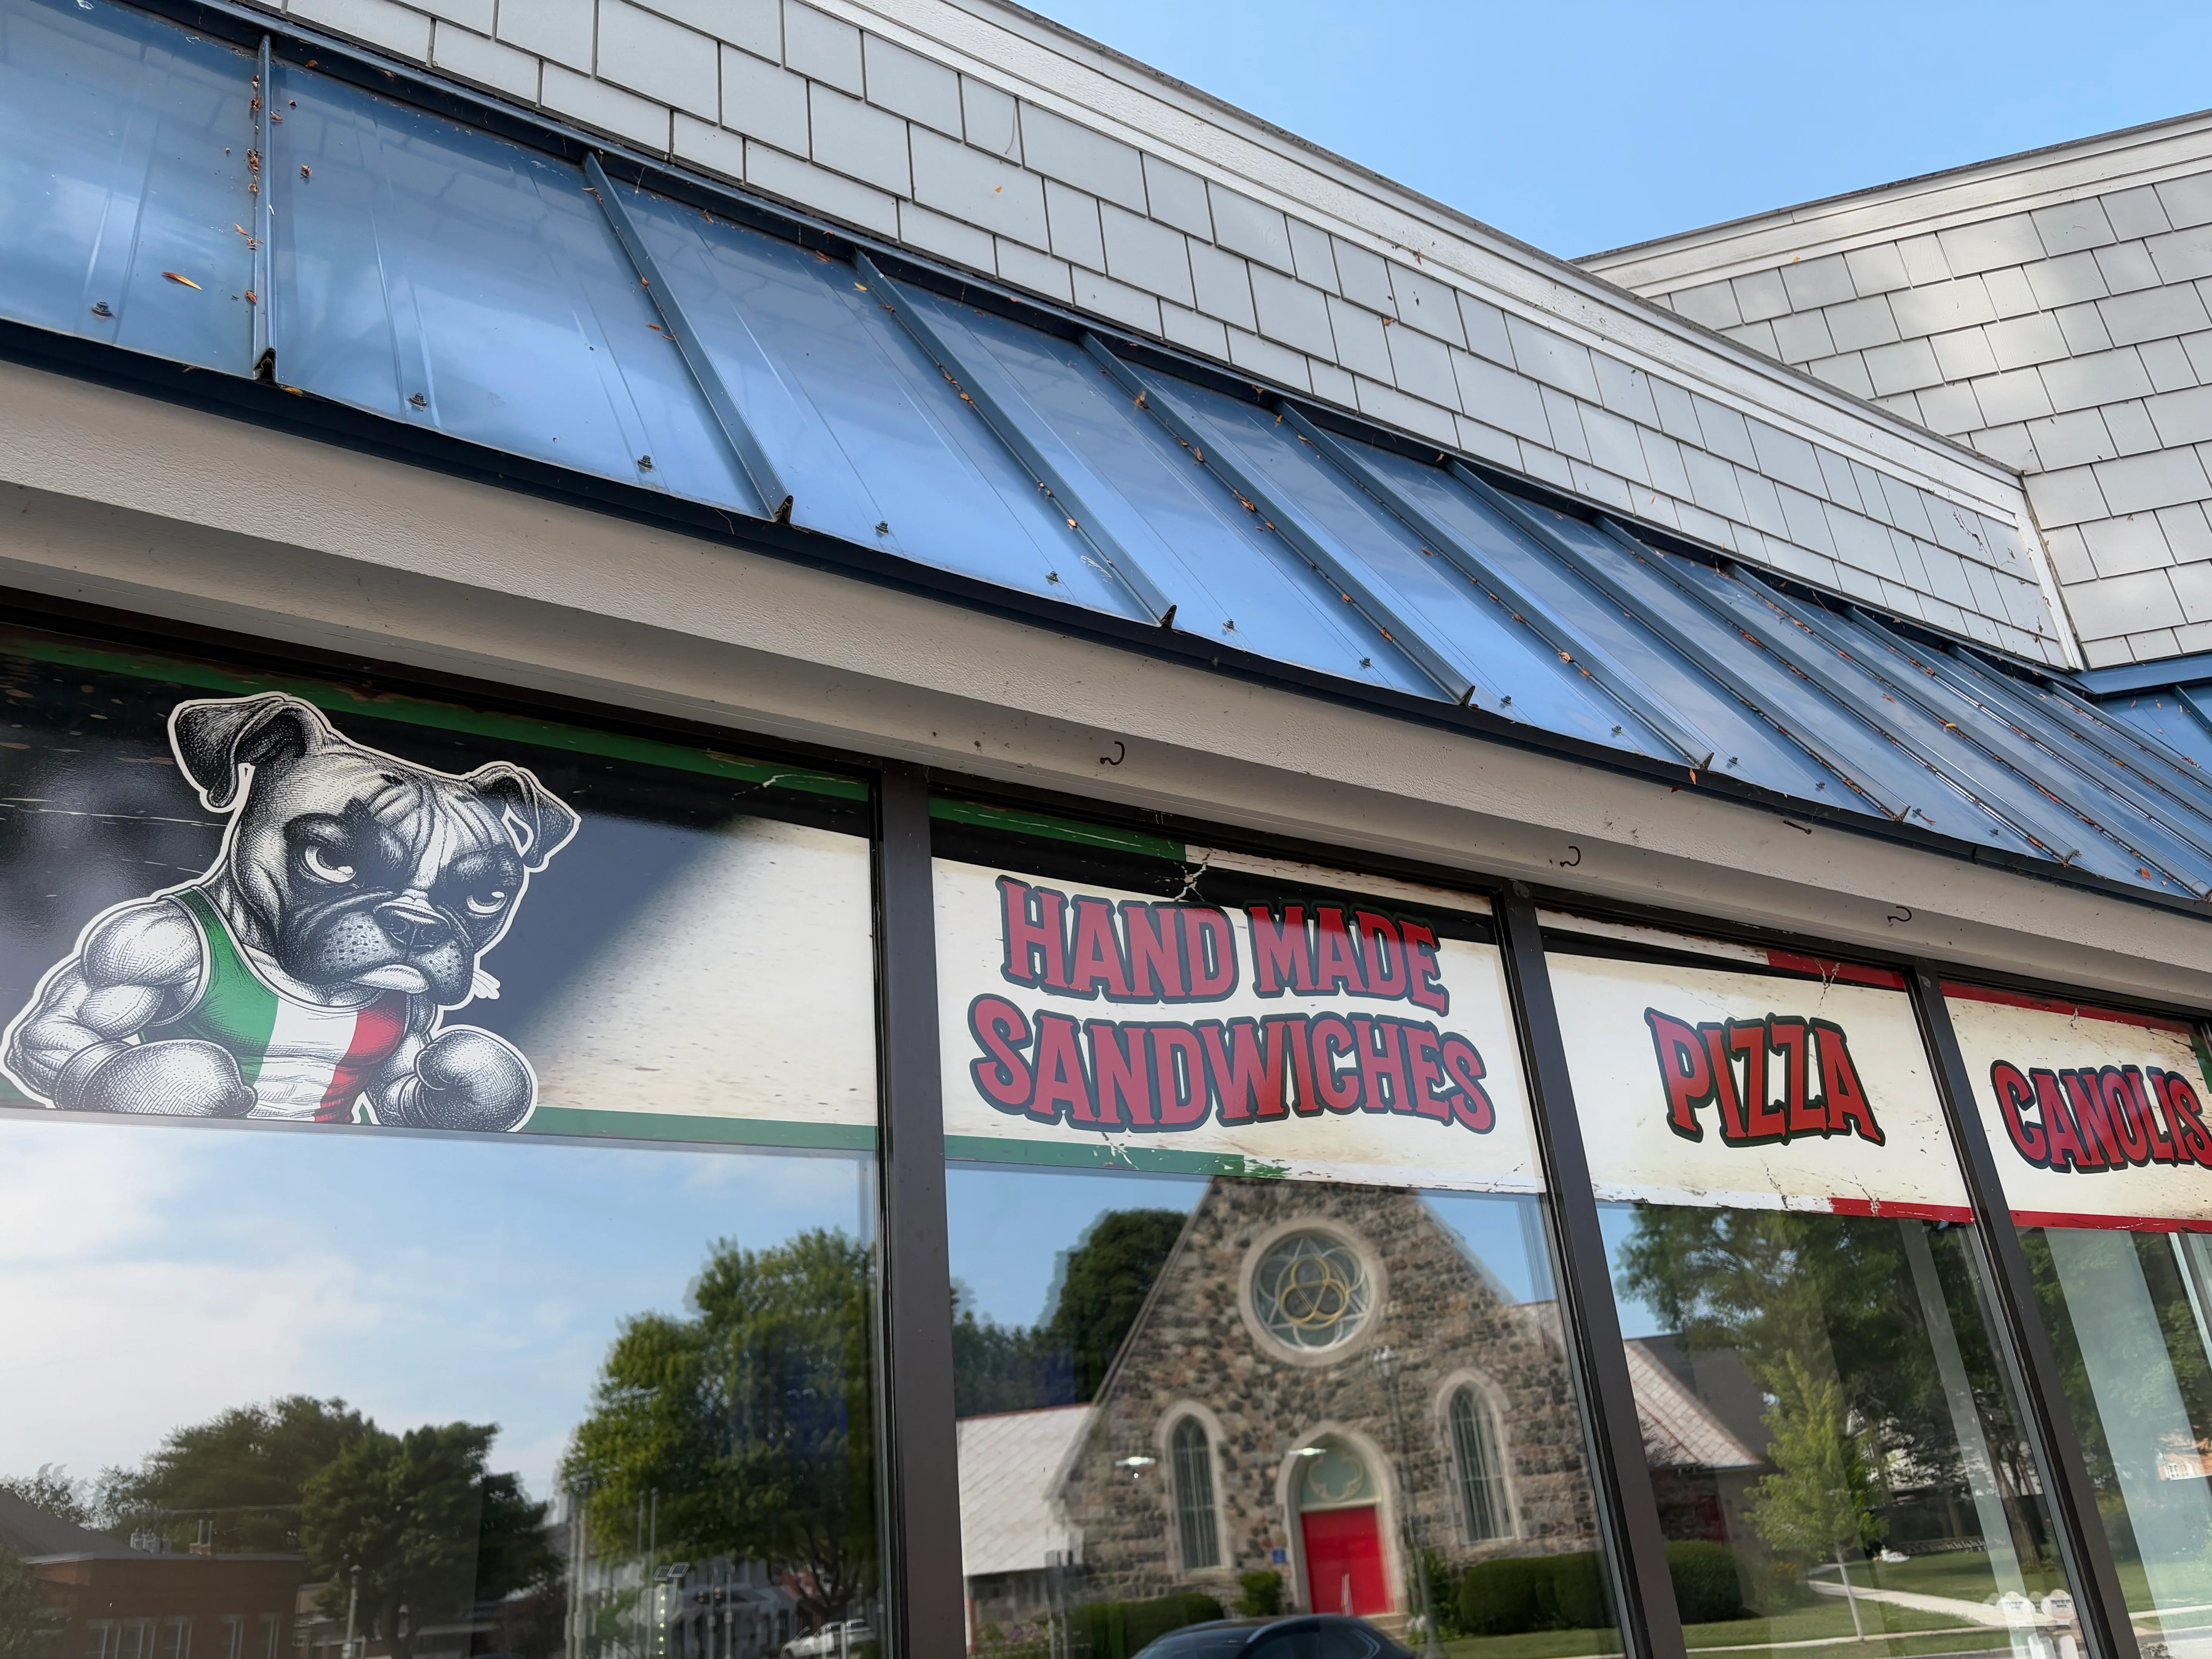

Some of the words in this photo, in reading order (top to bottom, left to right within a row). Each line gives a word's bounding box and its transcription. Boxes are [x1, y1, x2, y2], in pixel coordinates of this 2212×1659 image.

[994, 874, 1240, 1003] HAND
[1242, 899, 1449, 1017] MADE
[967, 993, 1496, 1134] SANDWICHES
[1643, 1006, 1886, 1147] PIZZA
[1990, 1059, 2212, 1174] CANOLIS
